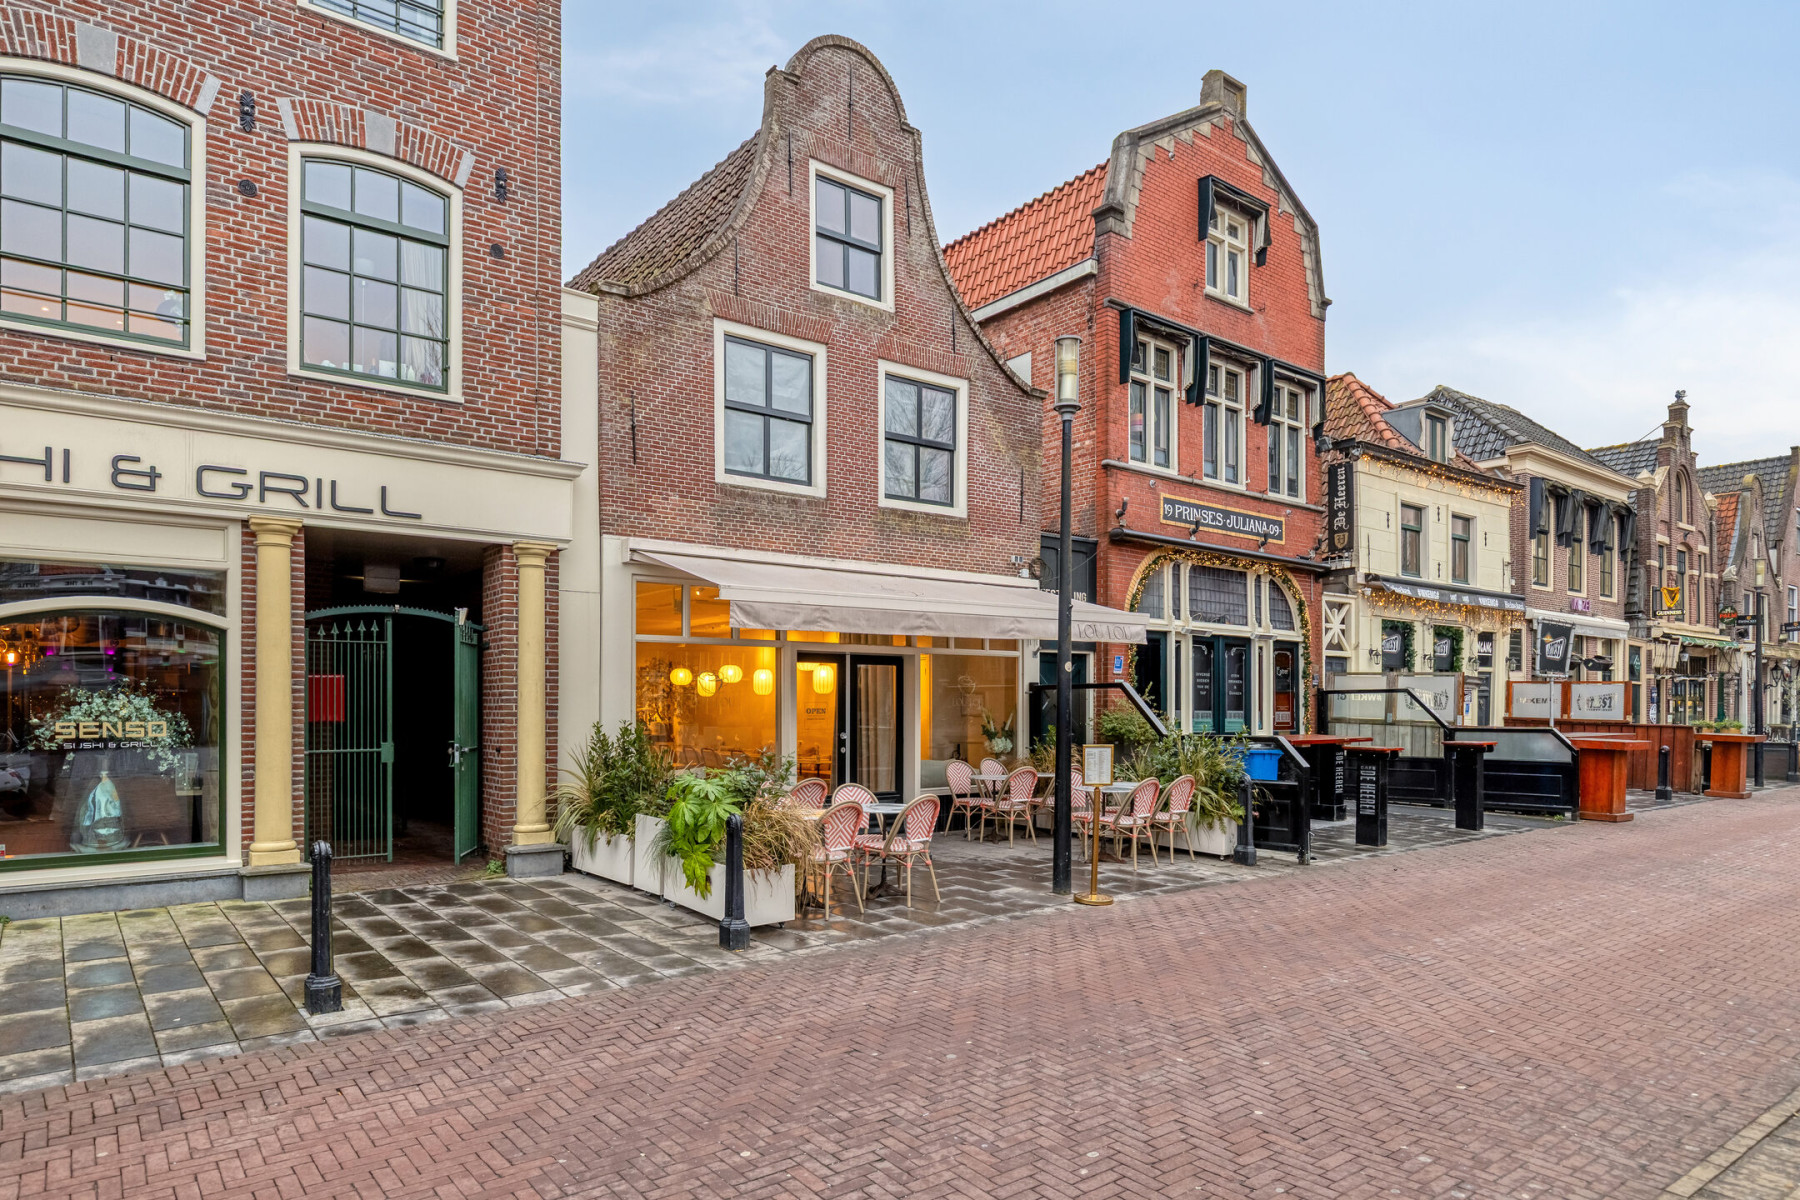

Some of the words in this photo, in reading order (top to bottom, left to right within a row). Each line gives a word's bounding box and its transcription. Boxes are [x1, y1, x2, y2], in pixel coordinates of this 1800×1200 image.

[111, 454, 162, 491] &
[196, 465, 422, 519] GRILL
[1164, 503, 1173, 516] 19
[1175, 504, 1223, 526] PRINSES
[1226, 515, 1268, 533] JULIANA
[55, 721, 167, 739] SENSO
[63, 742, 104, 750] SUSHI
[1360, 770, 1376, 780] DE
